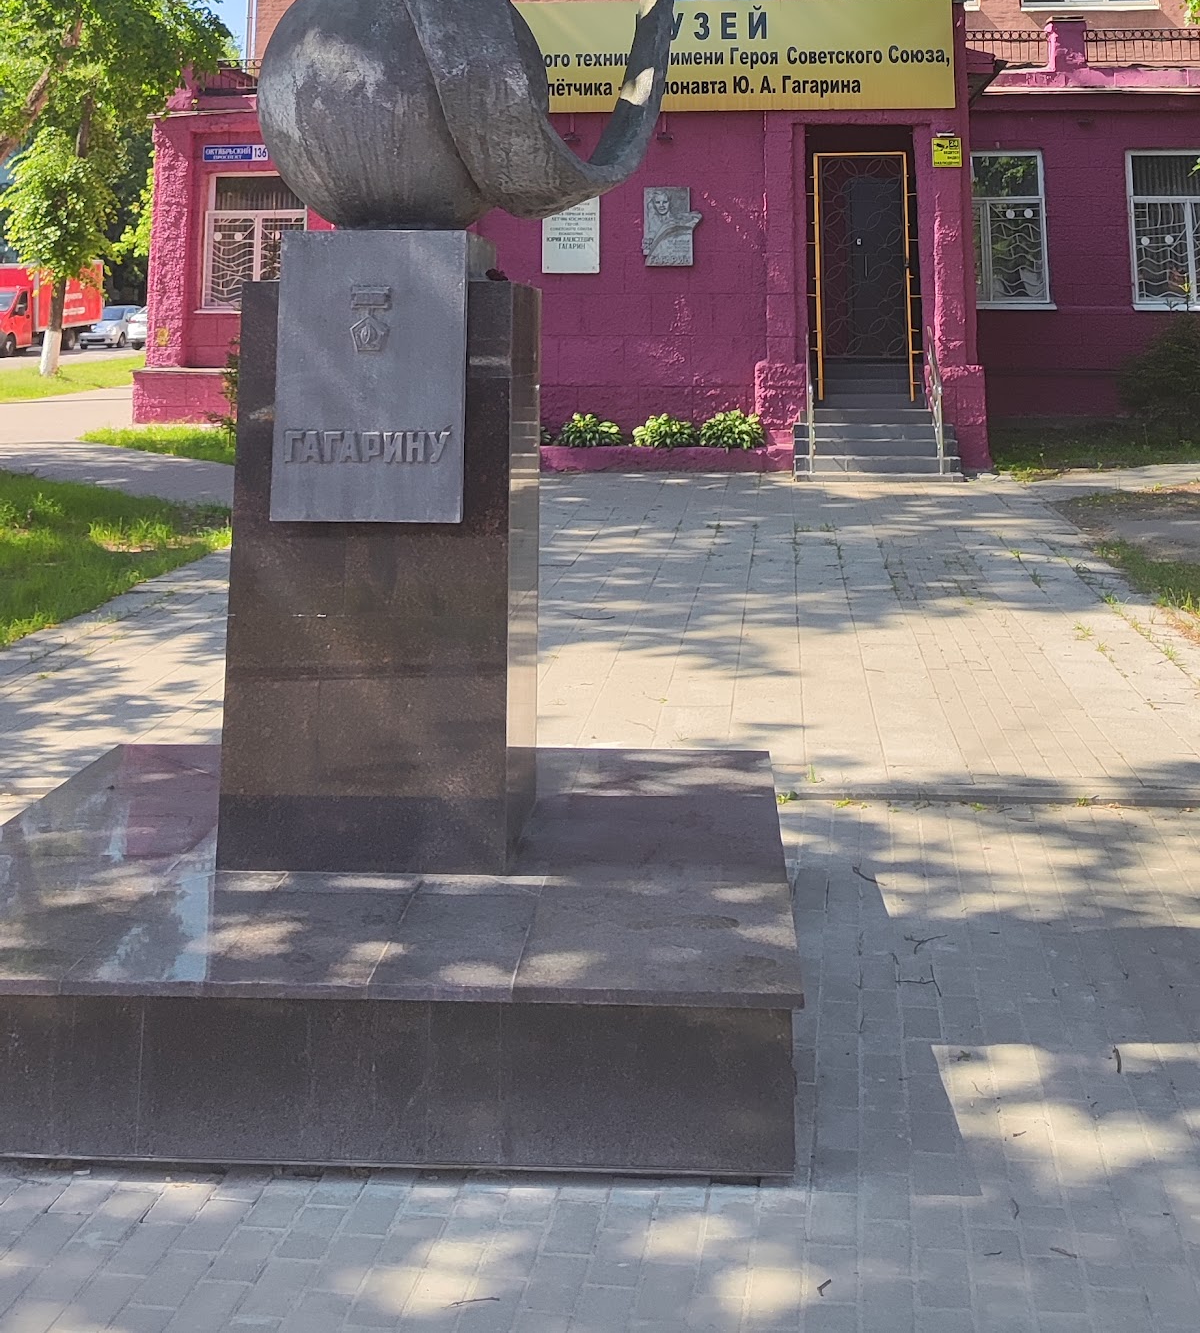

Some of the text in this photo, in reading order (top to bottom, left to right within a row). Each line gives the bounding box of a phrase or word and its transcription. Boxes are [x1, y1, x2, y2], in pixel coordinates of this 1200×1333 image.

[636, 5, 767, 40] УЗЕЙ
[541, 53, 570, 68] ого
[670, 51, 724, 66] имени
[729, 47, 779, 70] Героя
[786, 46, 883, 65] Советского
[888, 45, 950, 67] Союза,
[732, 75, 754, 94] Ю.
[759, 75, 776, 94] А.
[782, 75, 861, 98] Гагарина
[253, 147, 267, 158] 136
[284, 424, 453, 464] ГАГАРИНУ
